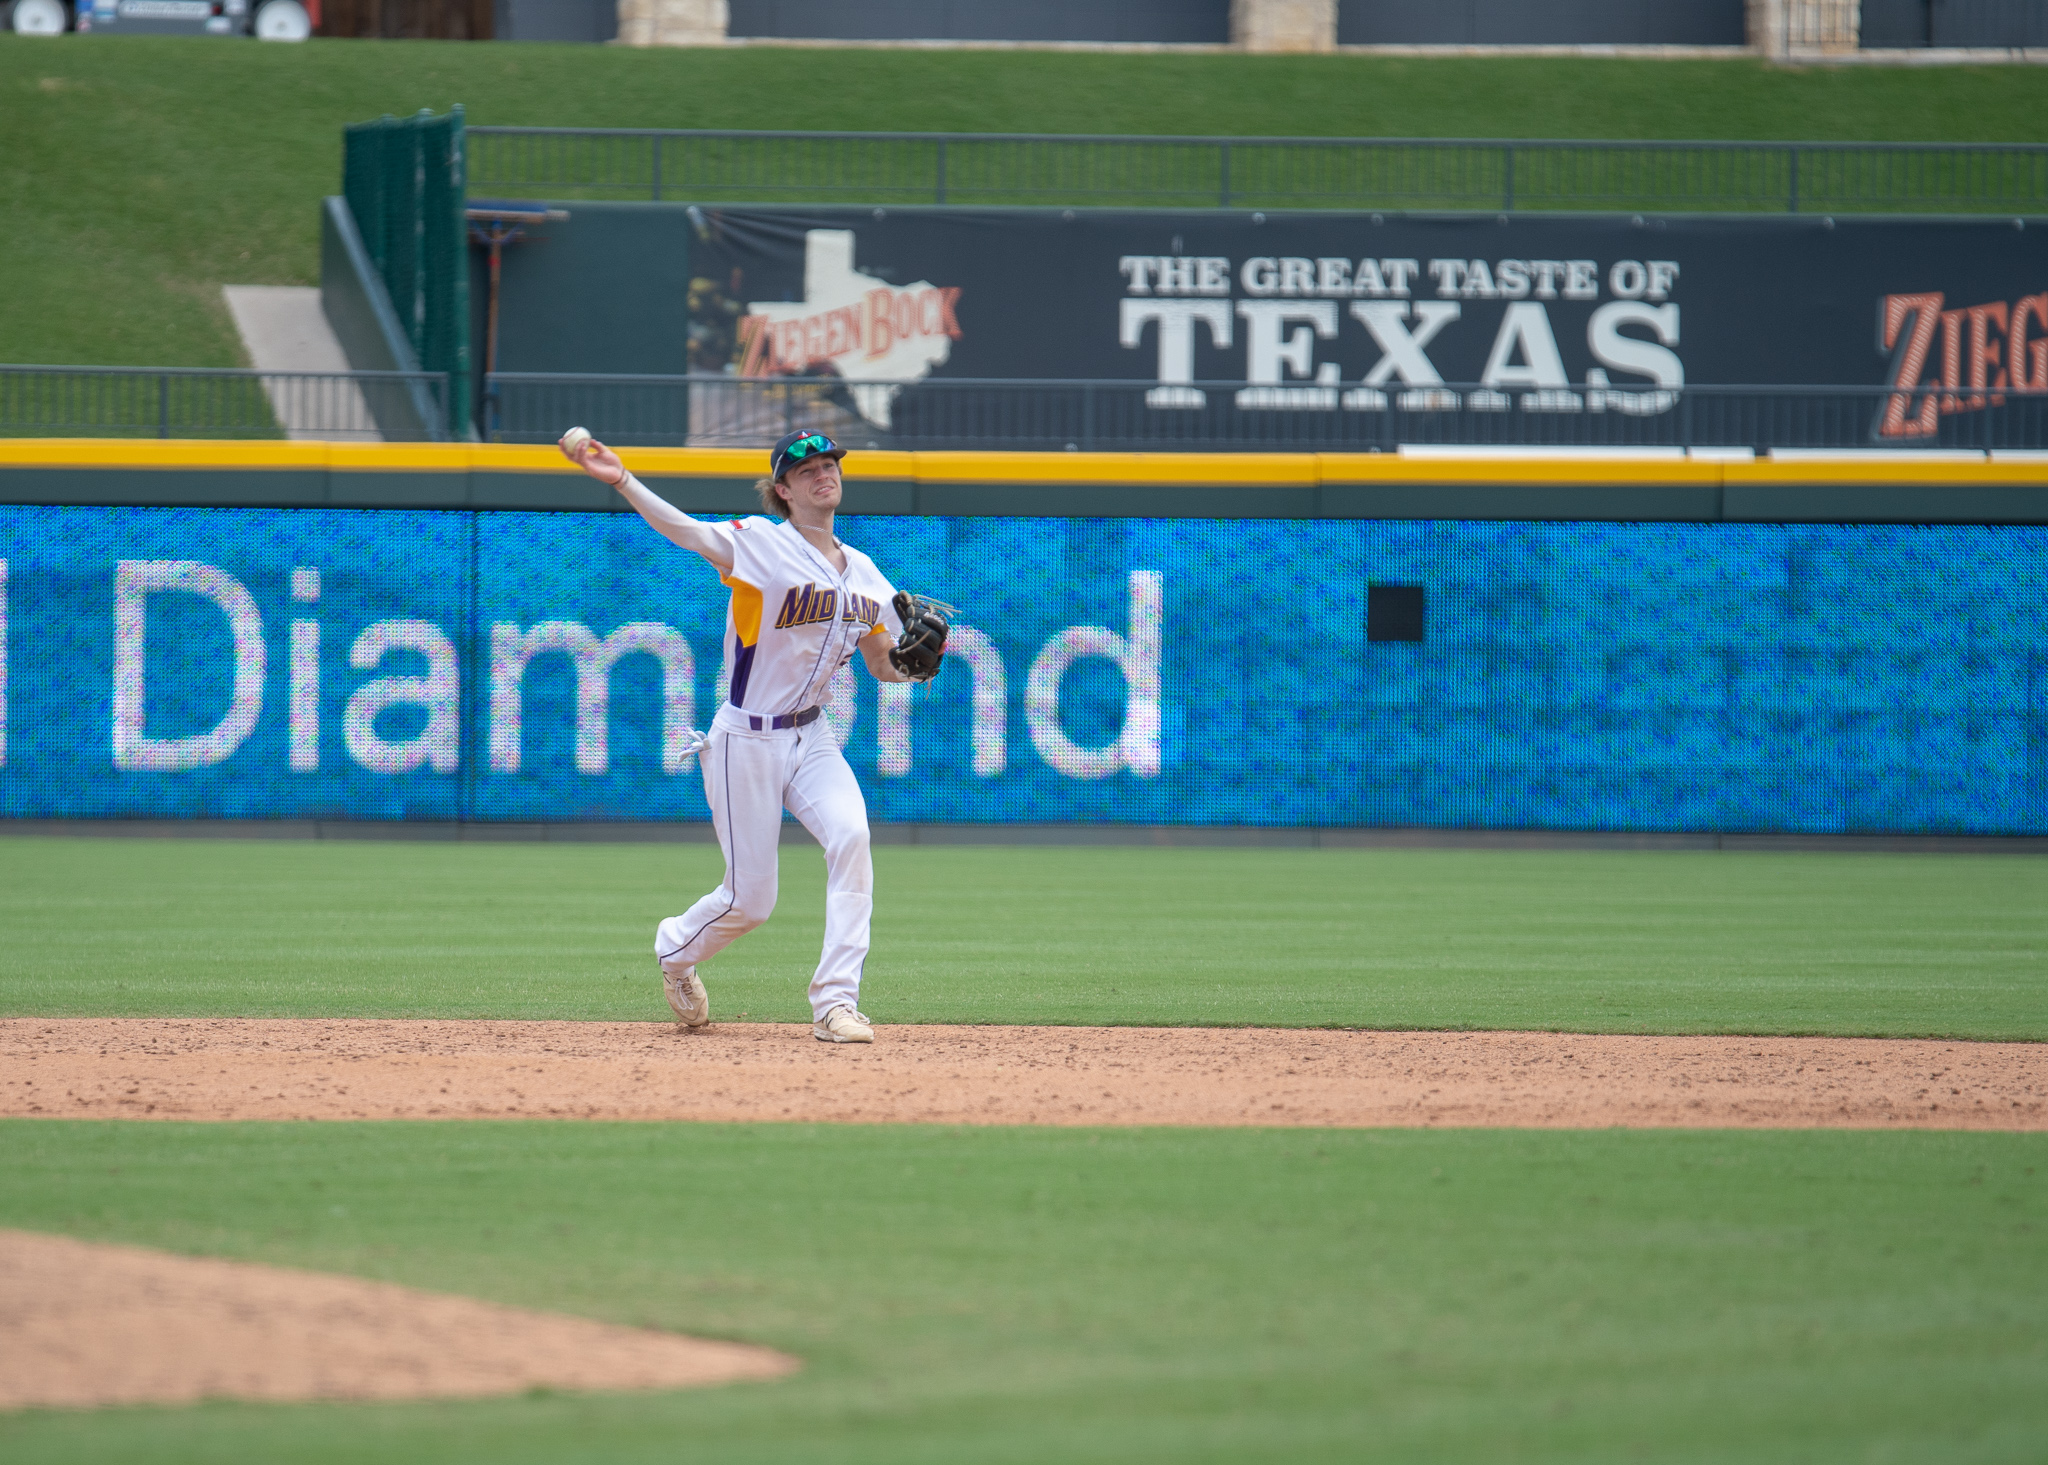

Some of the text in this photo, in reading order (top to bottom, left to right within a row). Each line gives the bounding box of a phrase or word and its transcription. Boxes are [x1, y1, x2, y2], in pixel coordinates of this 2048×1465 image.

[1118, 255, 1681, 301] THE GREAT TASTE OF
[1118, 298, 1686, 416] TEXAS
